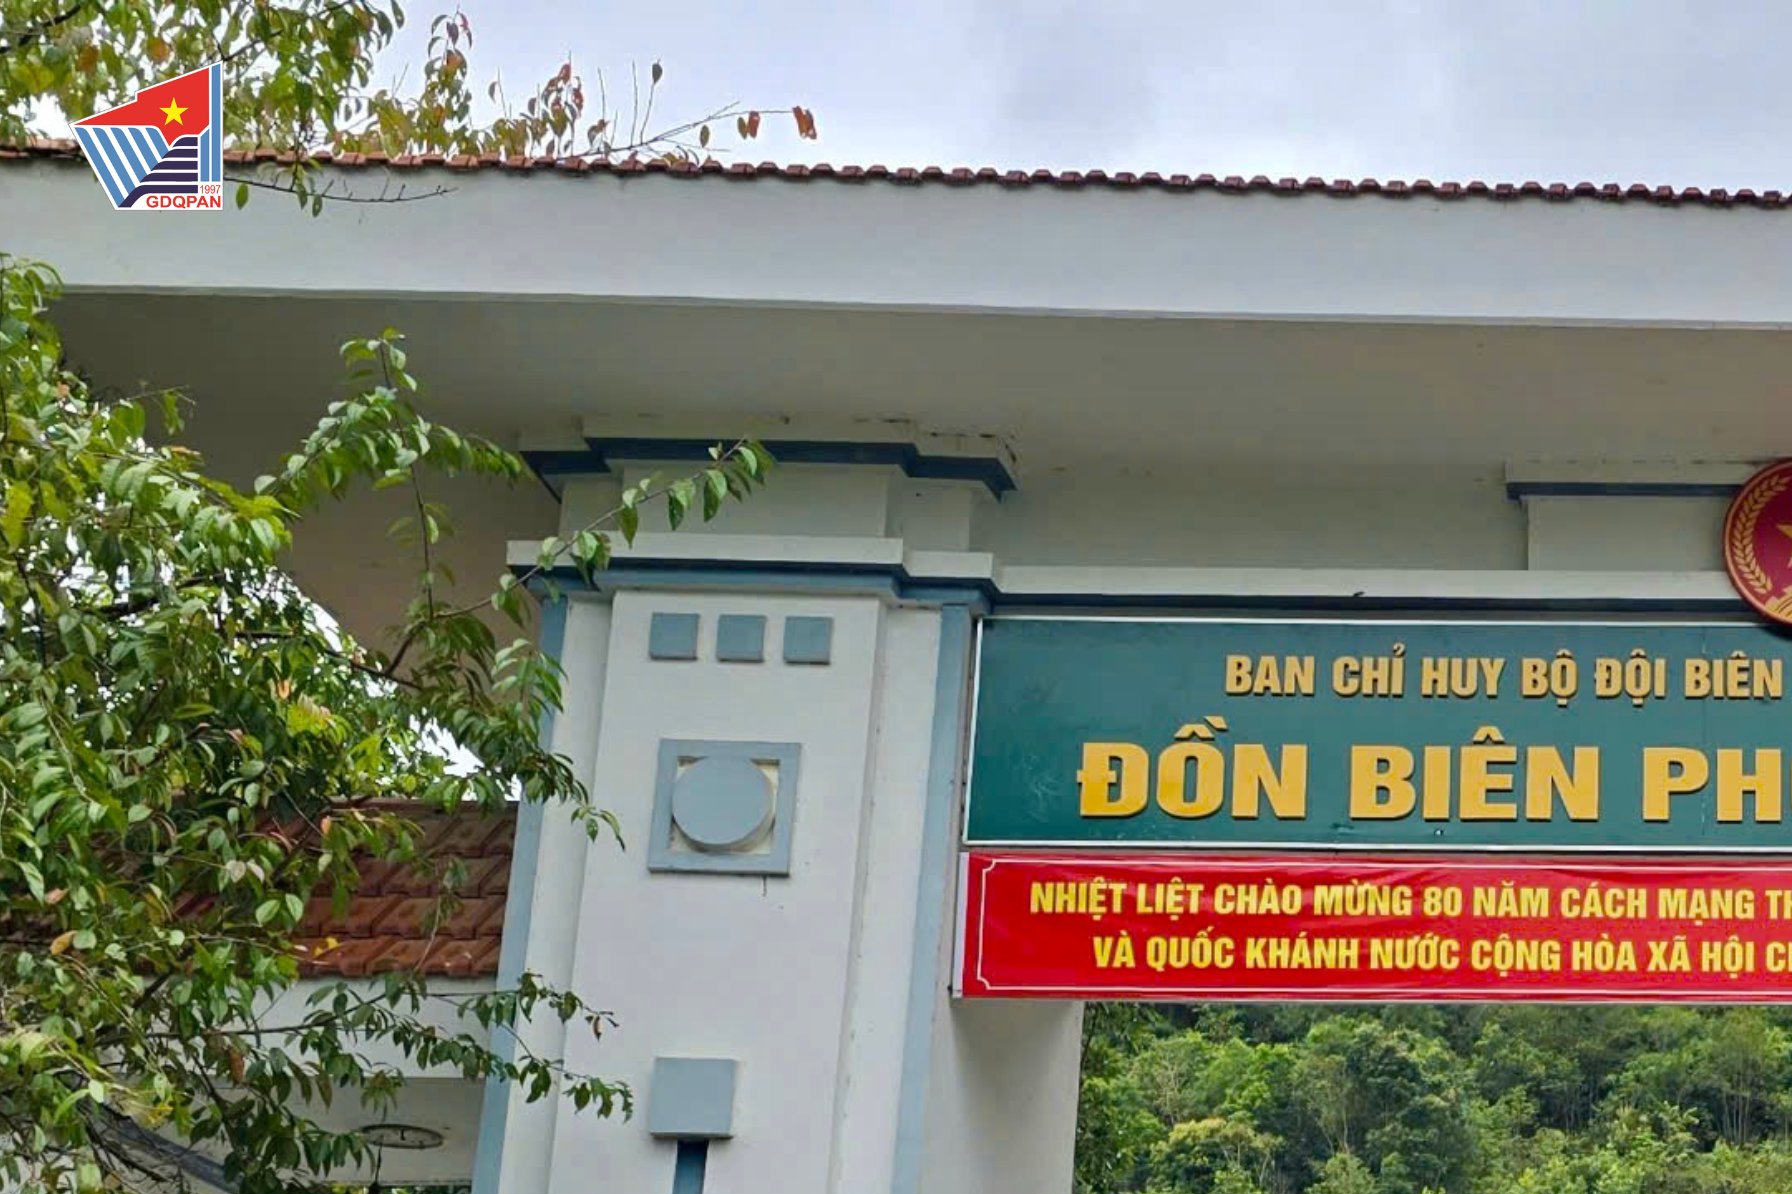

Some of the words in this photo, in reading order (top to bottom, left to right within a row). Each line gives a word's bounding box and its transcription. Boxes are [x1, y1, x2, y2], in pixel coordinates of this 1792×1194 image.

[1226, 655, 1315, 696] BAN
[1333, 643, 1404, 697] CHỈ
[1421, 656, 1504, 698] HUY
[1521, 649, 1577, 706] BỘ
[1595, 649, 1667, 706] ĐỘI
[1685, 650, 1783, 699] BIÊN
[1077, 715, 1309, 819] ĐỒN
[1349, 726, 1601, 821] BIÊN
[1030, 876, 1127, 920] NHIỆT
[1136, 878, 1205, 920] LIỆT
[1213, 879, 1303, 916] CHÀO
[1311, 880, 1412, 918] MỪNG
[1421, 884, 1463, 917] 80
[1472, 880, 1551, 918] NĂM
[1560, 883, 1648, 920] CÁCH
[1656, 886, 1755, 922] MẠNG
[1093, 931, 1137, 970] VÀ
[1146, 929, 1235, 973] QUỐC
[1244, 932, 1360, 971] KHÁNH
[1368, 932, 1459, 972] NƯỚC
[1470, 932, 1562, 974] CỘNG
[1571, 933, 1638, 973] HÒA
[1648, 934, 1692, 973] XÃ
[1700, 933, 1756, 977] HỘI
